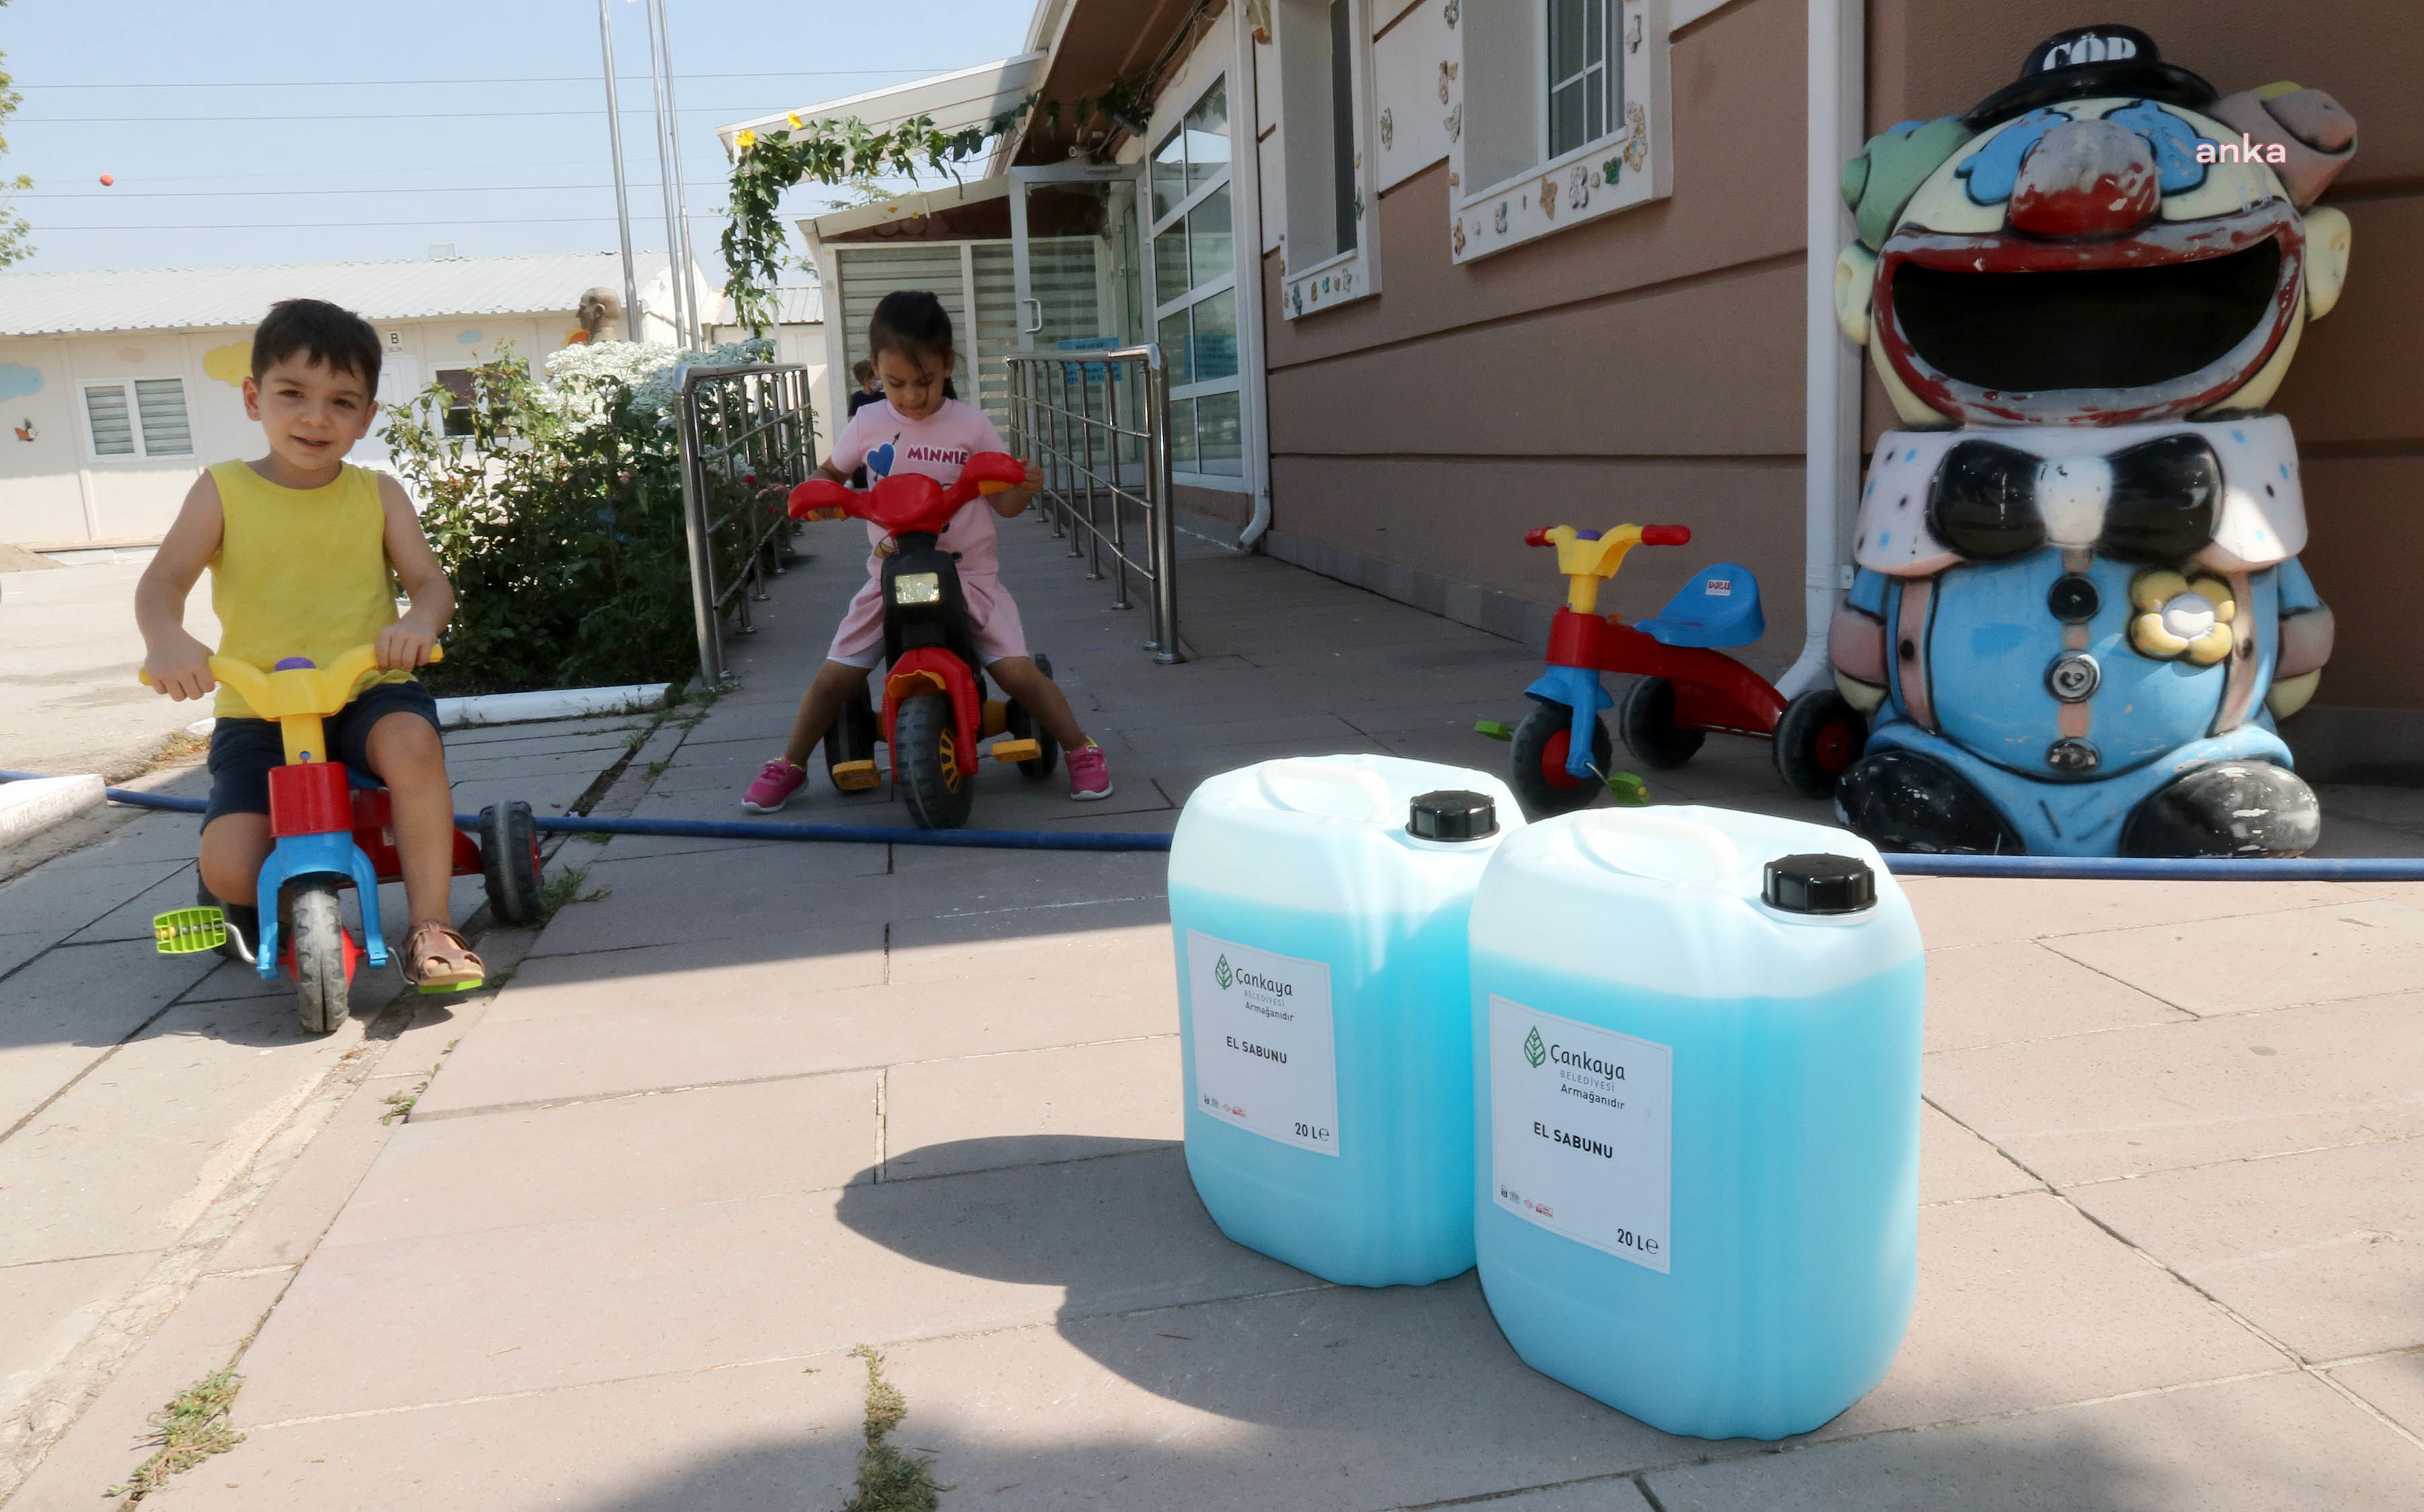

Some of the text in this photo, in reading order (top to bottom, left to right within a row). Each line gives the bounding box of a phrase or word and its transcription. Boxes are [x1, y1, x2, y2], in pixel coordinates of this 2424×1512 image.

[391, 333, 398, 344] B
[907, 447, 968, 465] MINNIE
[1236, 968, 1293, 997] Çankaya
[1244, 990, 1285, 1007] BELEDİYESİ
[1245, 1001, 1294, 1021] Armağanıdır
[1226, 1036, 1287, 1064] EL SABUNU
[1550, 1044, 1626, 1081] Çankaya
[1560, 1069, 1615, 1092] BELEDİYESİ
[1561, 1084, 1625, 1110] Armağanıdır
[1295, 1122, 1308, 1137] 20
[1534, 1121, 1613, 1159] EL SABUNU
[1617, 1228, 1633, 1247] 20
